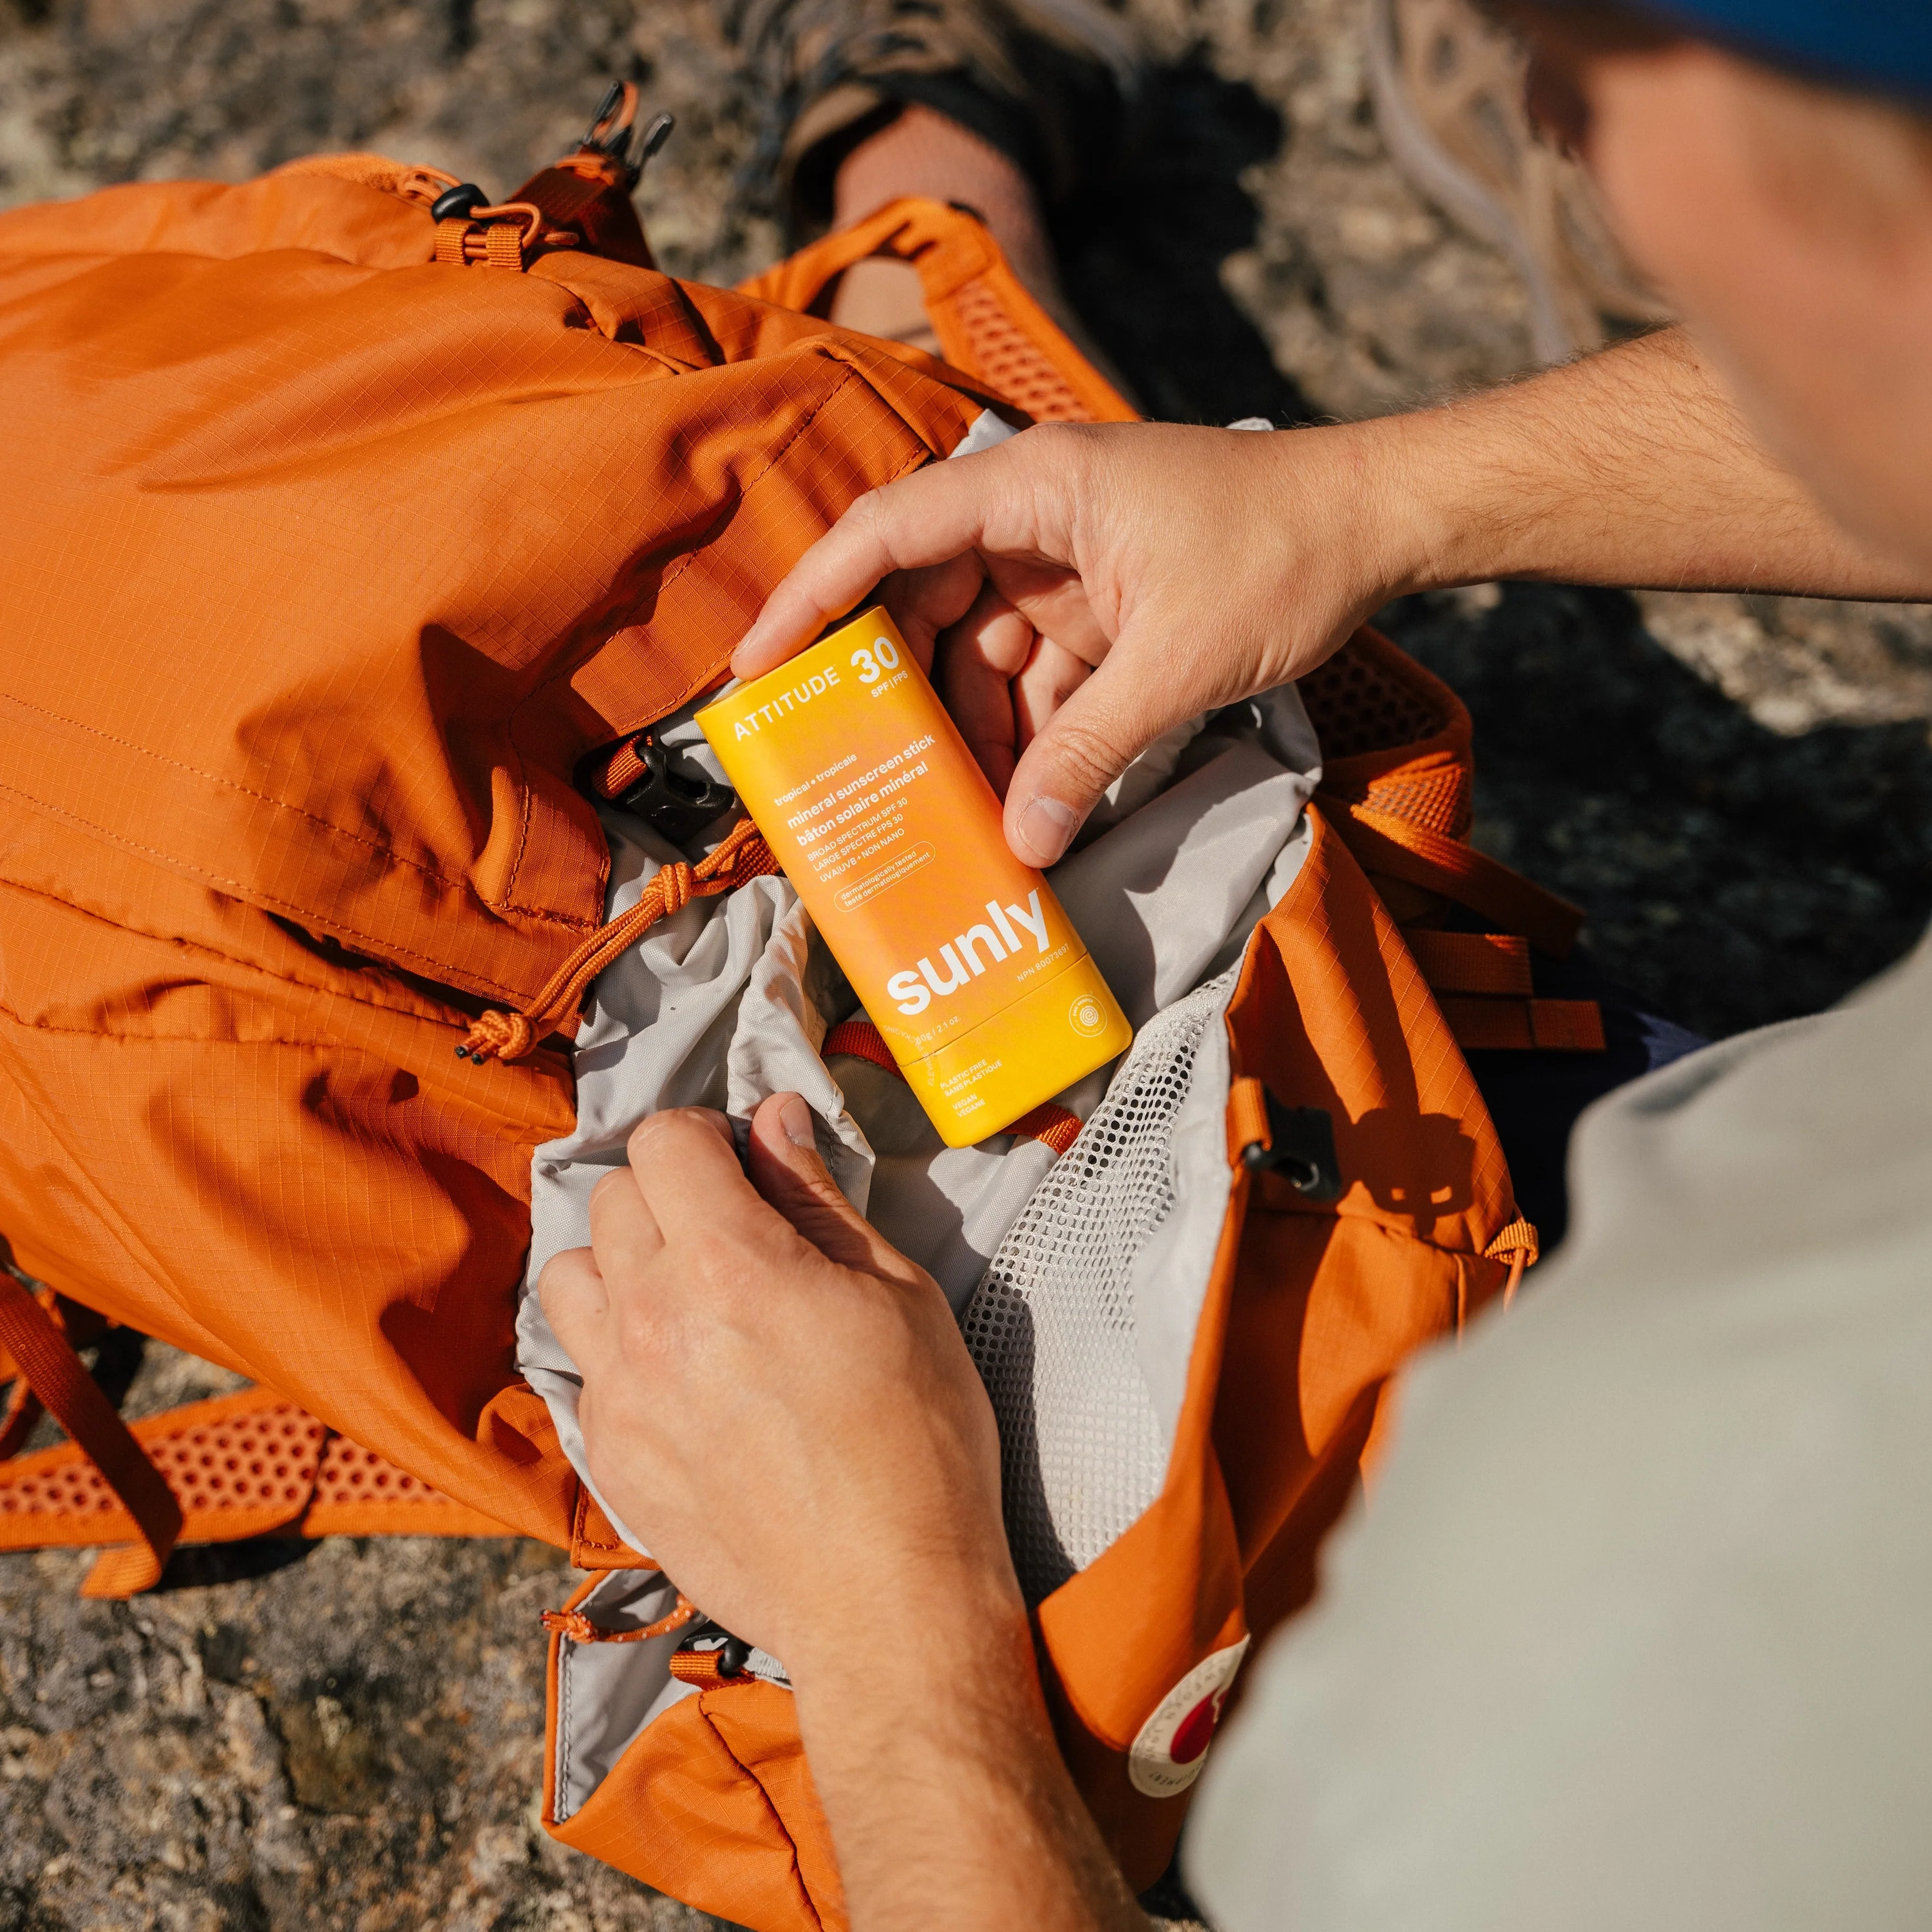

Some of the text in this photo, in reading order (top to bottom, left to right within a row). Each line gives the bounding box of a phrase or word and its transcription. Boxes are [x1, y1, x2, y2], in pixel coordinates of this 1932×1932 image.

[851, 637, 898, 683] 30
[734, 667, 840, 741] ATTITUDE
[775, 755, 857, 806] tropical tropicale
[787, 734, 936, 828] mineral sunscreen stick
[797, 761, 928, 846] bâton solaire minéral
[808, 798, 907, 861] BROAD SPECTRUM SPF 30
[813, 814, 903, 871] LARGE SPECTRE FPS 30
[862, 843, 880, 858] NON
[880, 829, 904, 846] NANO
[840, 851, 916, 901] dermatologically tested
[845, 852, 930, 907] testé dermatologiquement
[886, 888, 1050, 1016] sunly
[1017, 943, 1069, 981] NPN 80073697
[940, 1059, 987, 1088] PLASTIC FREE
[945, 1060, 1002, 1096] SANS PLASTIQUE
[953, 1095, 977, 1110] VEGAN
